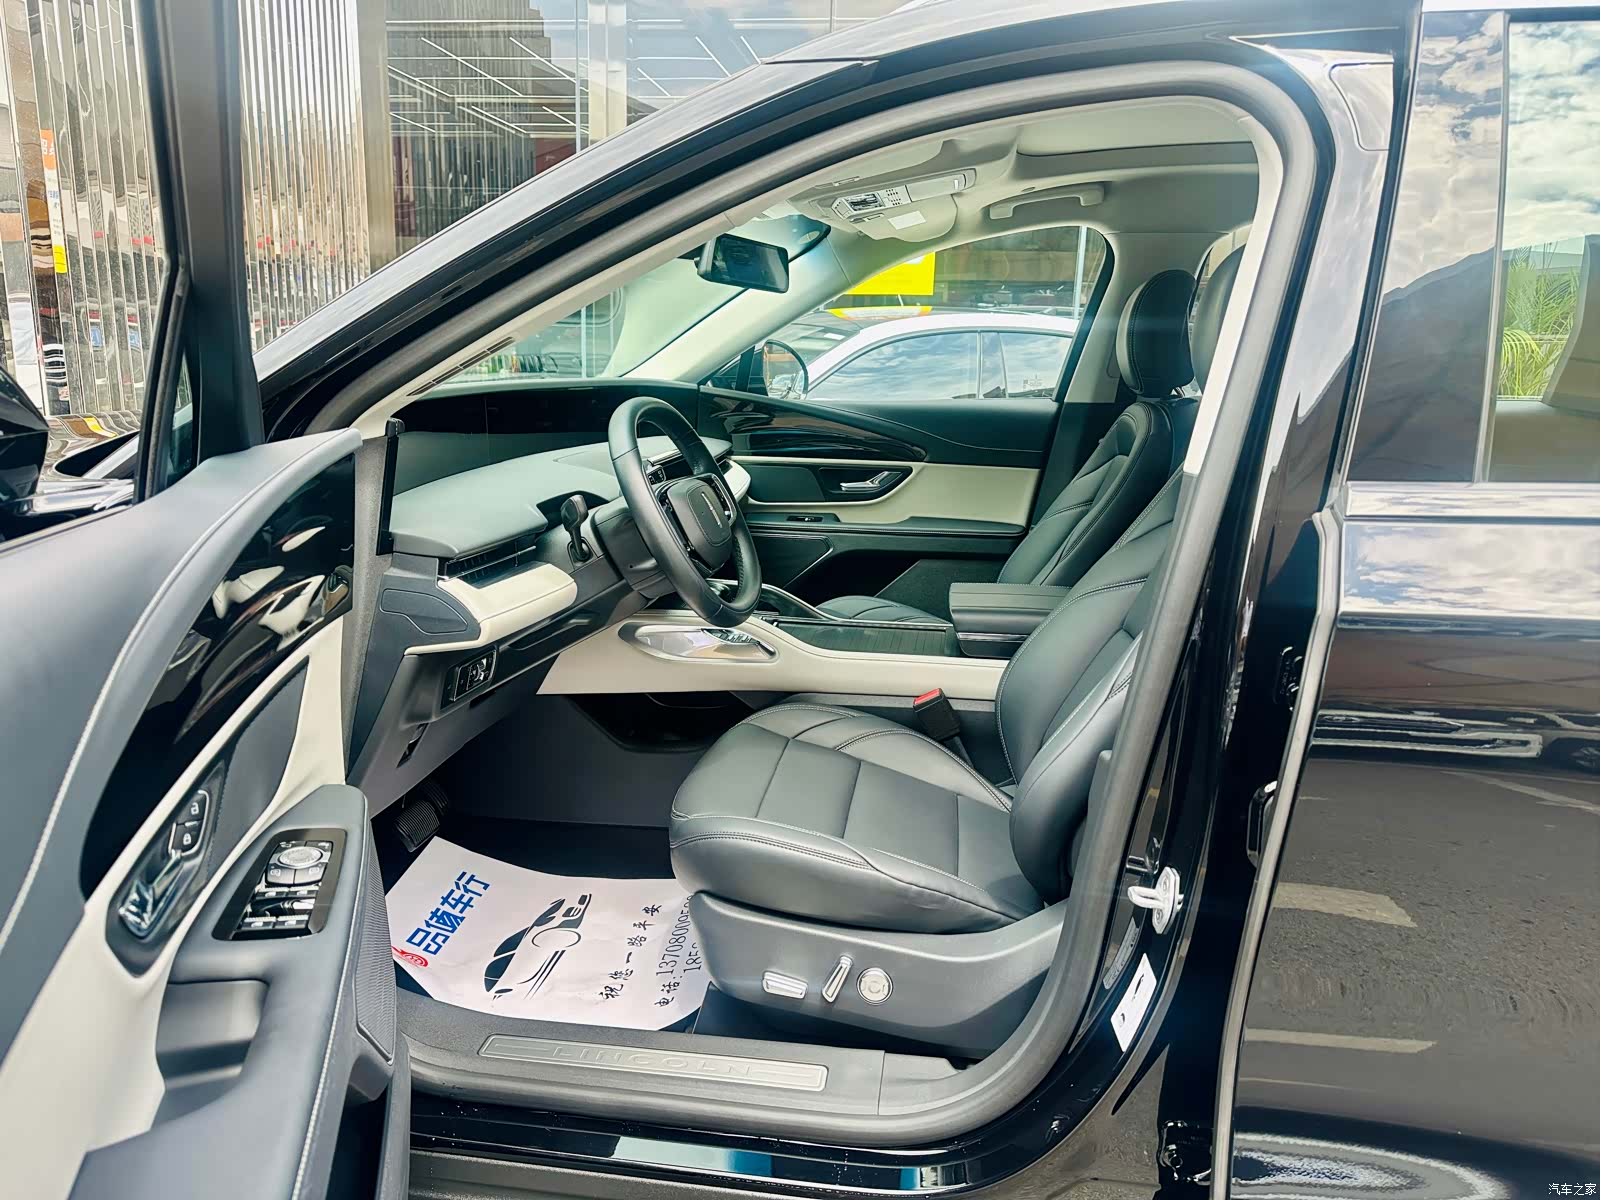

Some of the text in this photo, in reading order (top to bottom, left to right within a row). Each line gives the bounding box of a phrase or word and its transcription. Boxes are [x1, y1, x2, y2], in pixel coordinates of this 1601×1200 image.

[406, 871, 490, 956] 品德车行
[598, 904, 662, 1000] 祝您一路平安
[553, 1046, 751, 1077] LINCOLN
